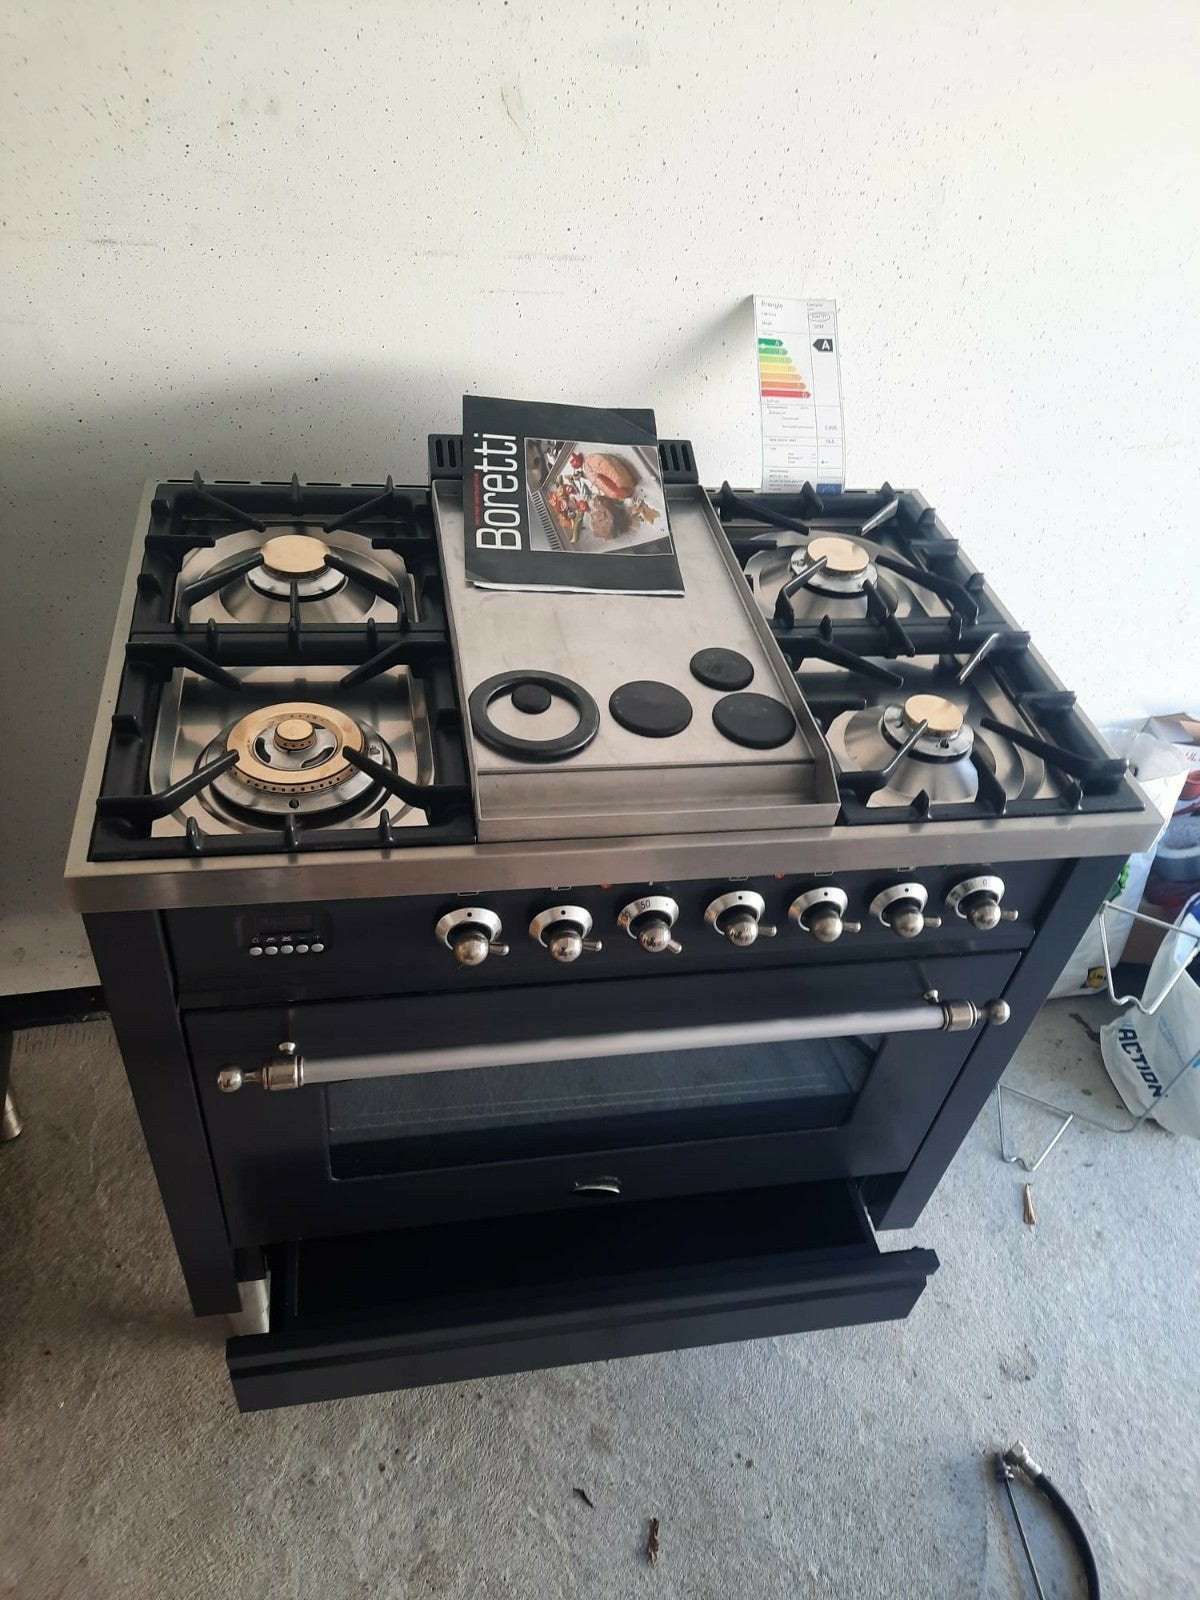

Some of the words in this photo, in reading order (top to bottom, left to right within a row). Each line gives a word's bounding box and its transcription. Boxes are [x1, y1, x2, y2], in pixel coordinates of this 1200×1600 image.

[821, 339, 831, 351] A
[473, 432, 522, 550] Boretti
[640, 899, 651, 910] 50
[1118, 1028, 1163, 1098] ACTION
